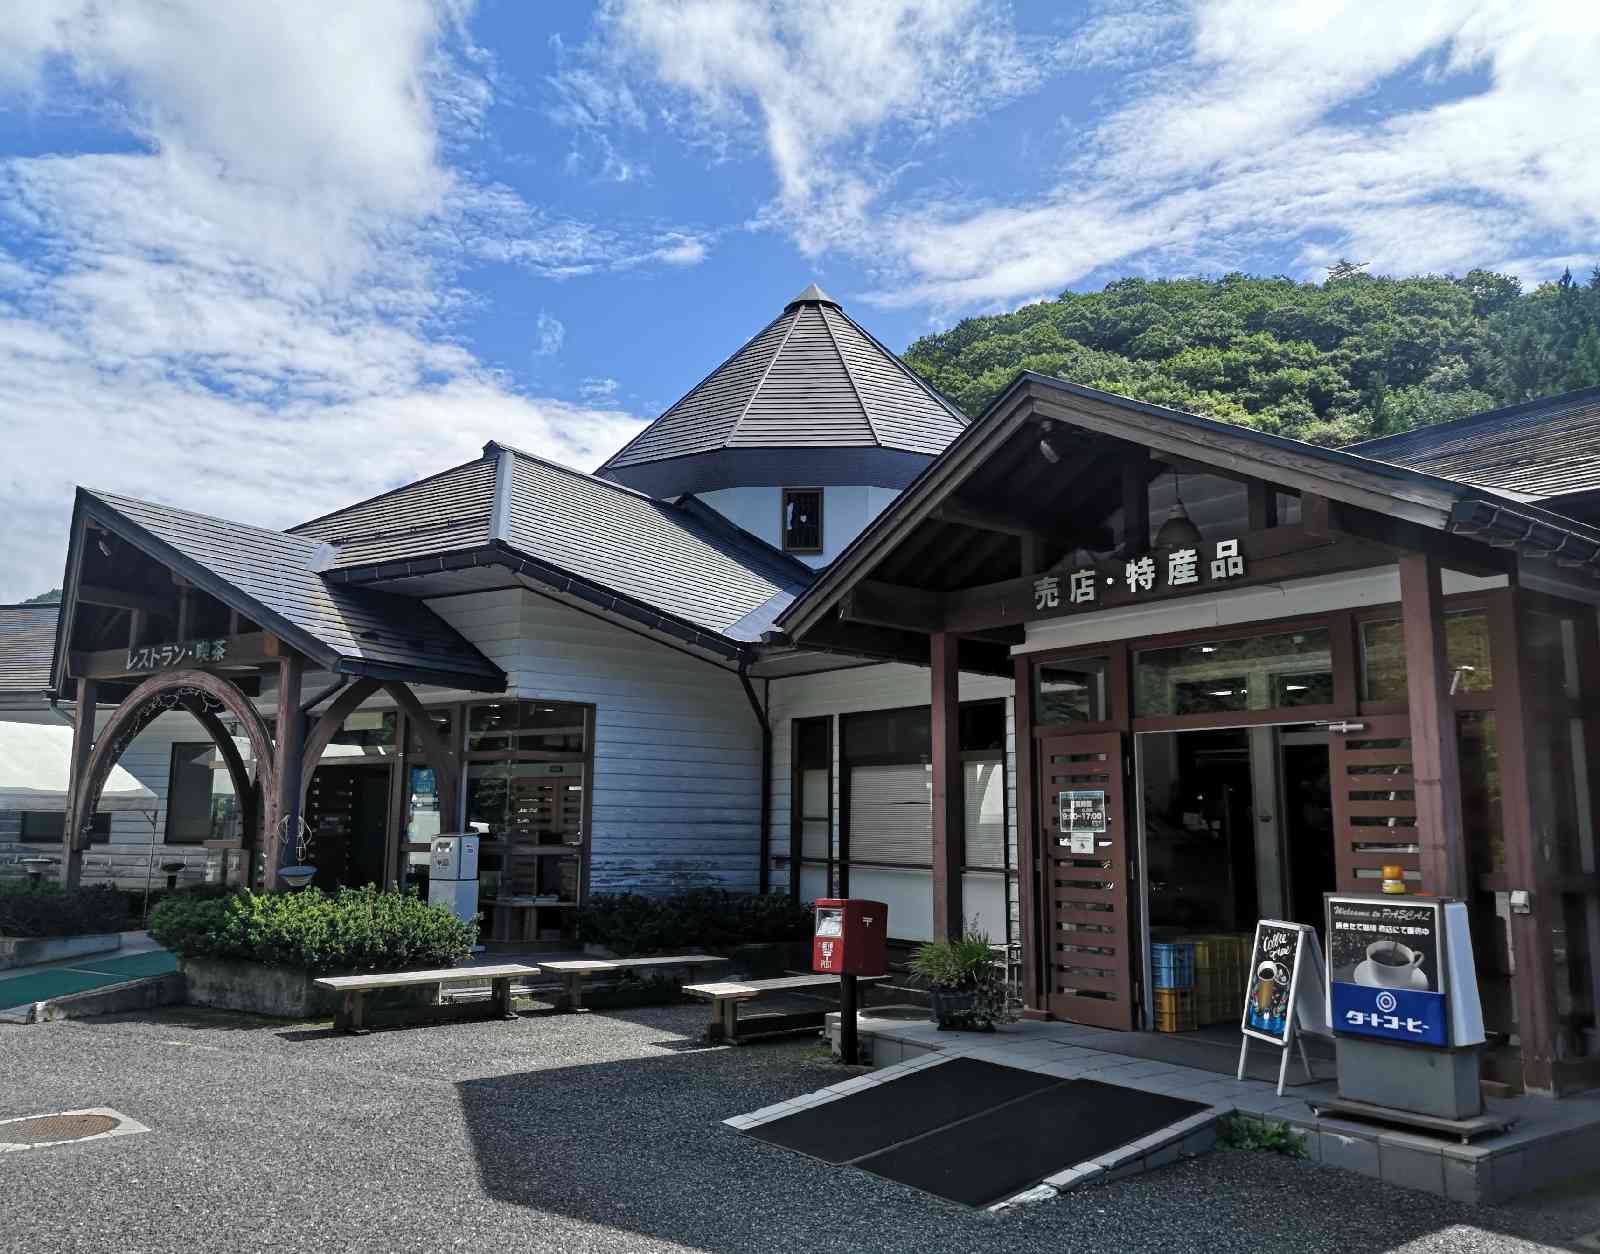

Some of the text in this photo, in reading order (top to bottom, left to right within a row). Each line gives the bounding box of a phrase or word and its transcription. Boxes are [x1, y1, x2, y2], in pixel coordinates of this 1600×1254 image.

[1033, 538, 1245, 610] 売店・特産品
[126, 639, 226, 670] レストラン・喫茶
[1334, 905, 1370, 917] Welcome
[1346, 1011, 1430, 1033] ダートコーヒー
